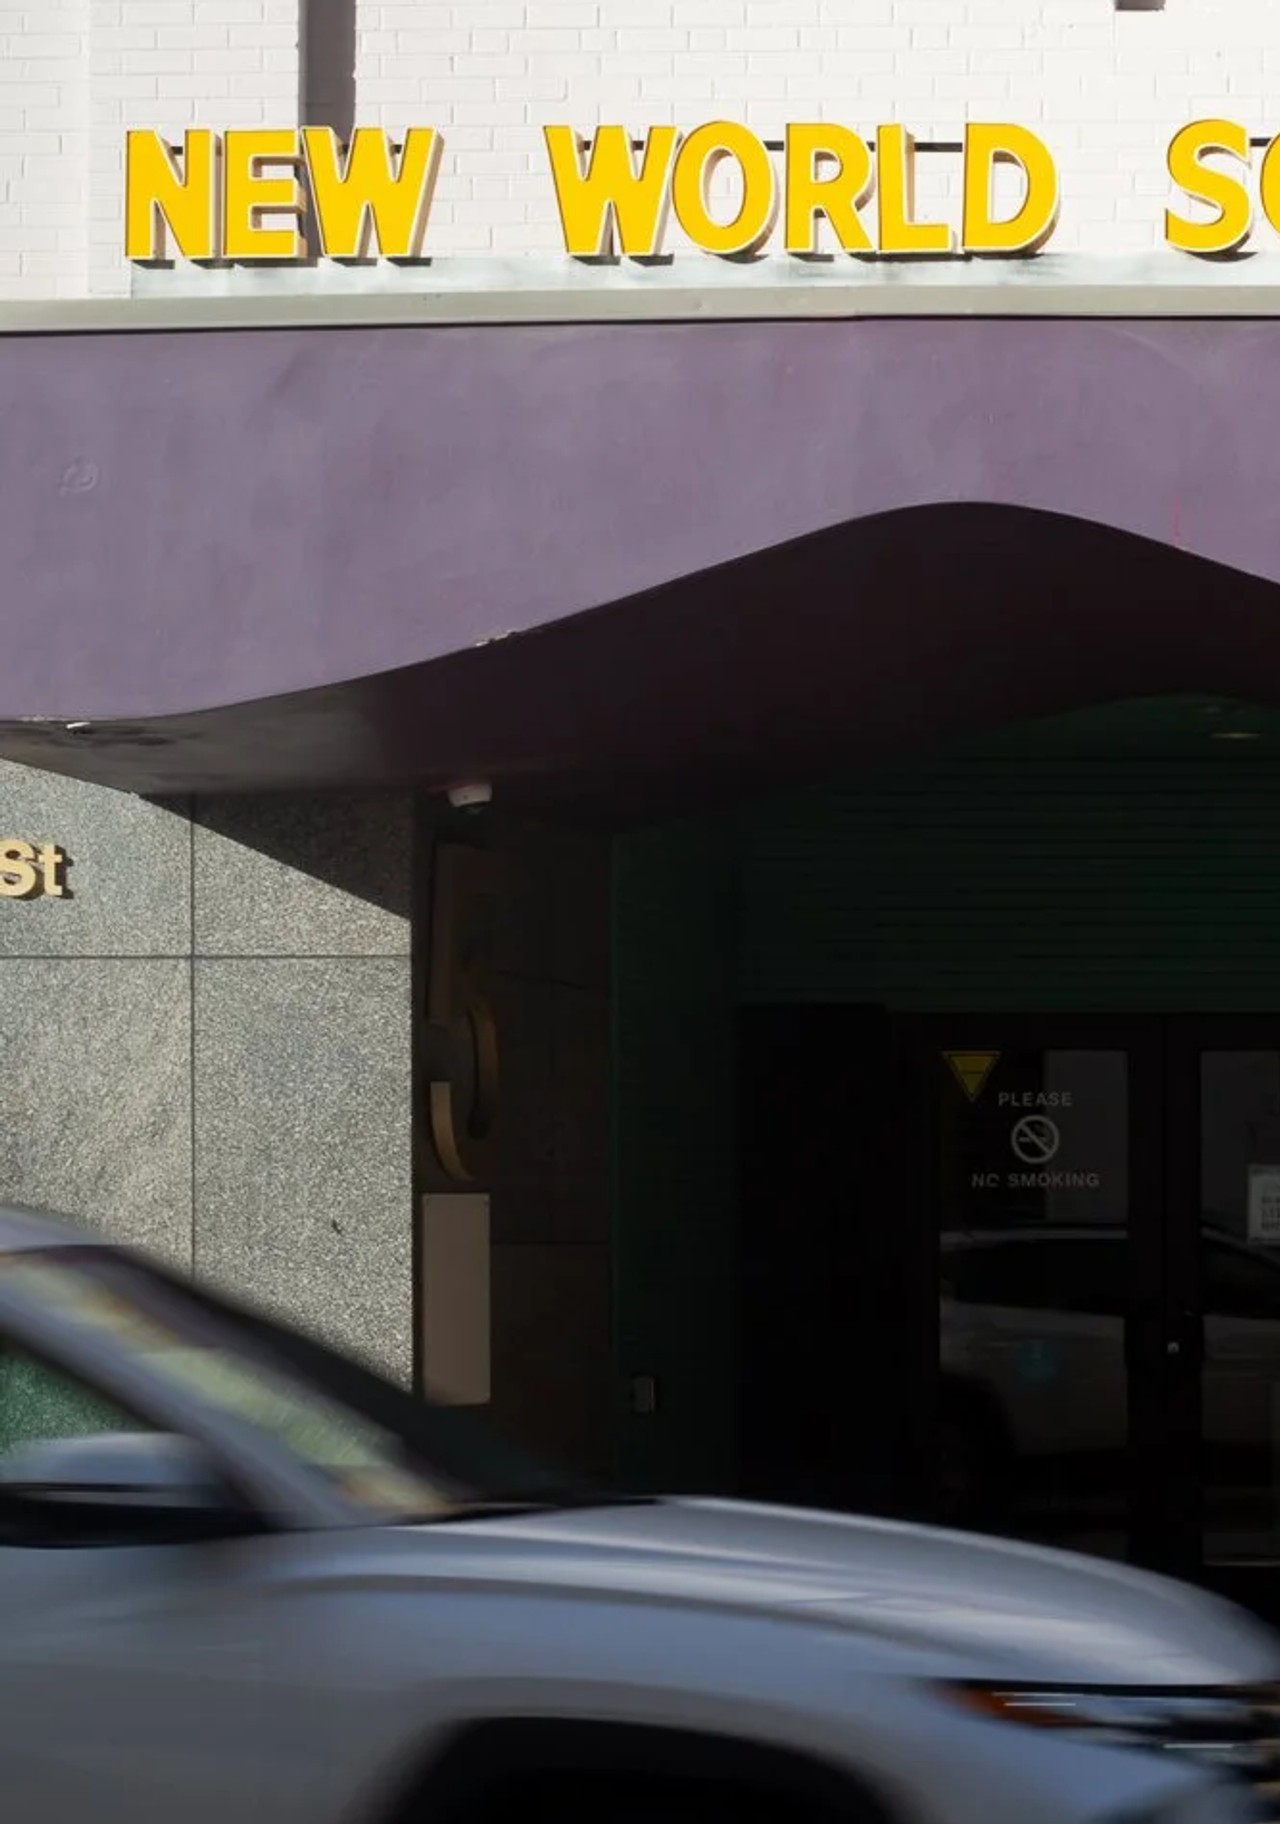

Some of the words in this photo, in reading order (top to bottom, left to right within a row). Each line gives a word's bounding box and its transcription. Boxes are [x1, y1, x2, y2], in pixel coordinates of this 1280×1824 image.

[123, 126, 440, 259] NEW
[541, 119, 1059, 256] WORLD
[0, 838, 64, 898] St
[997, 1091, 1074, 1108] PLEASE
[1006, 1171, 1102, 1189] SMOKING
